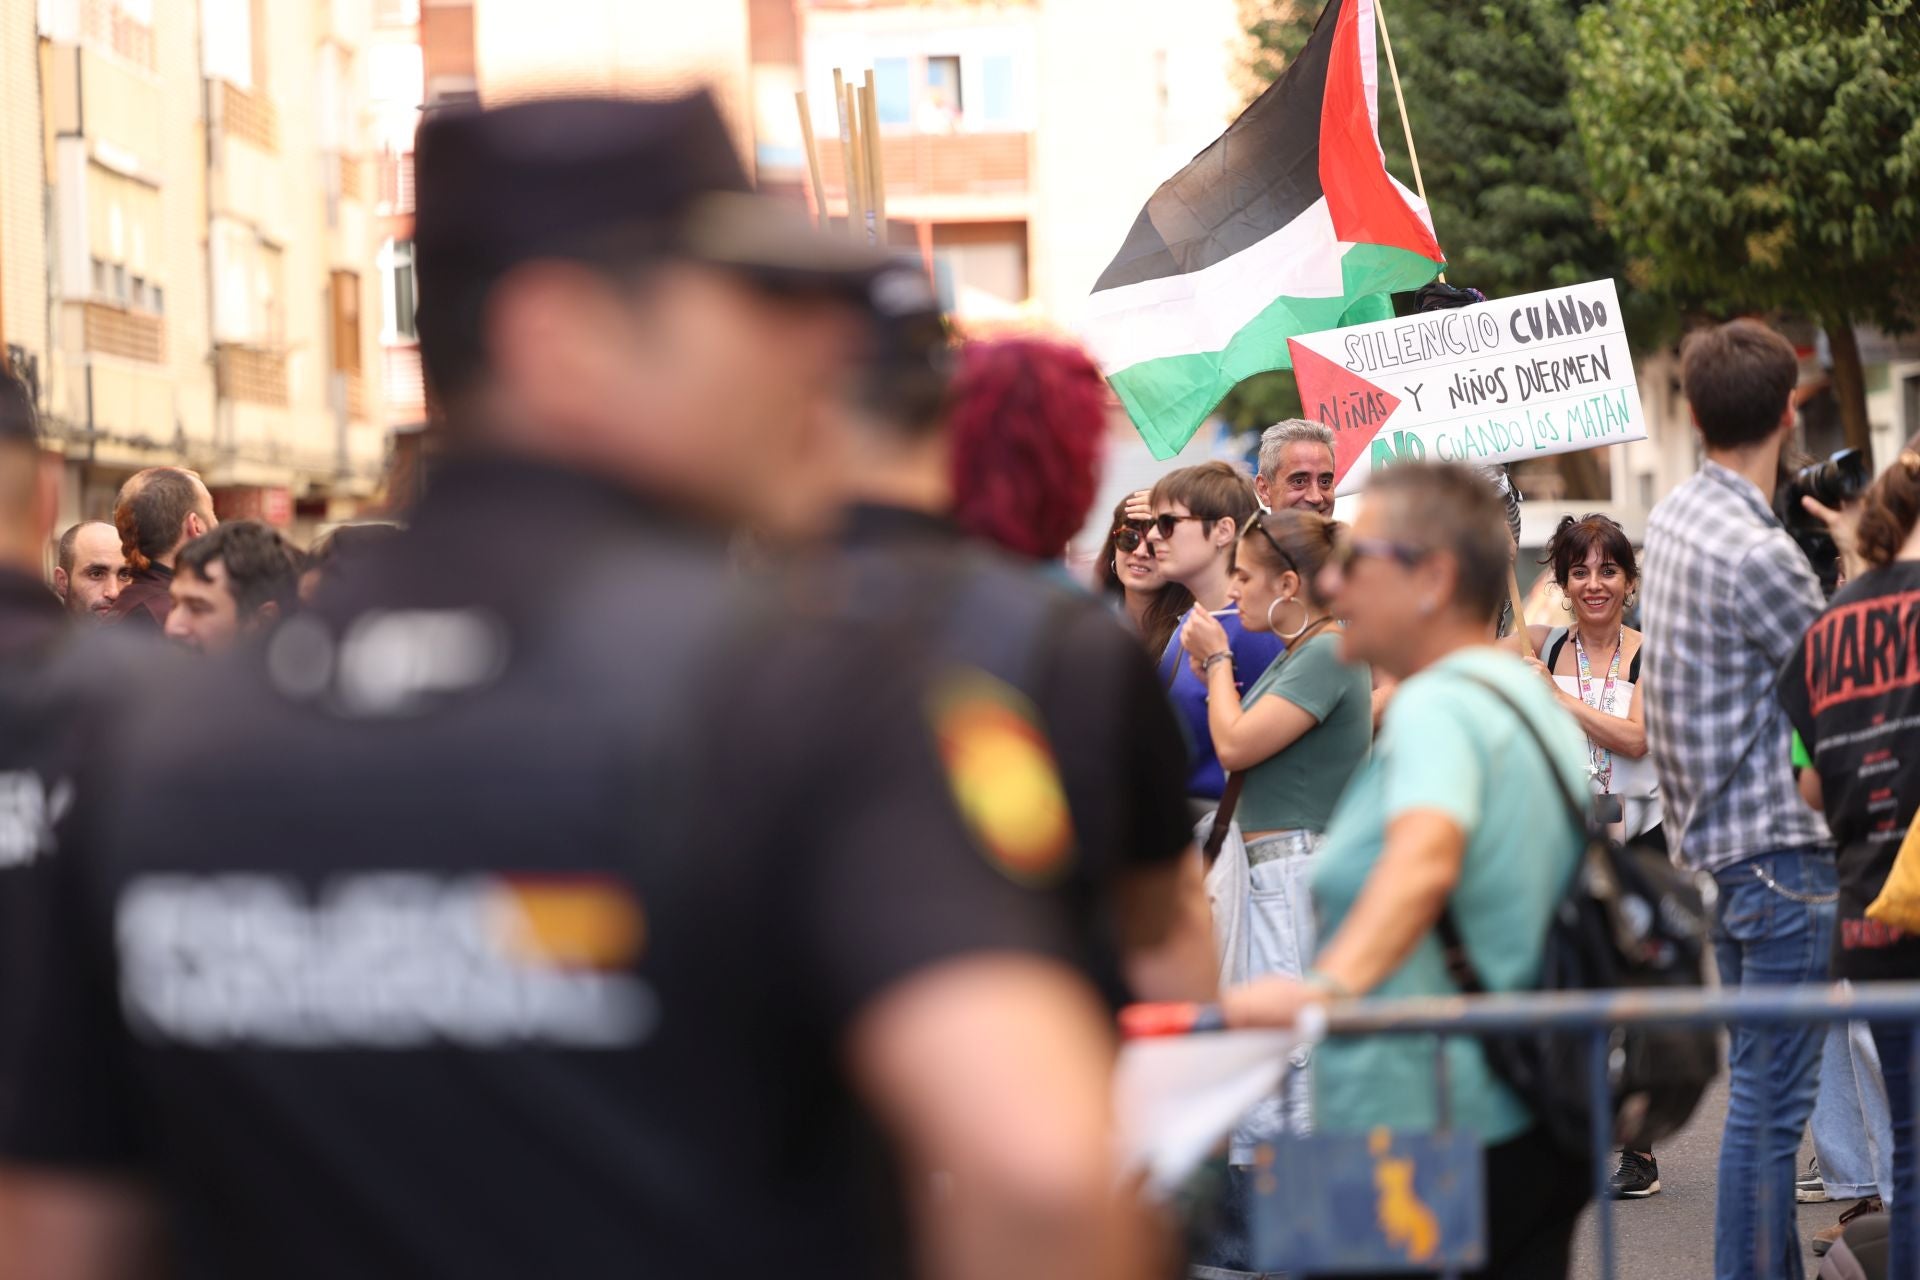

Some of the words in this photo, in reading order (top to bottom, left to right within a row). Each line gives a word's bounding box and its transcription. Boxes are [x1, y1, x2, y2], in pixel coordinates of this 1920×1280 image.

[1344, 312, 1500, 373] SILENCIO
[1509, 294, 1608, 344] CUANDO
[1404, 382, 1424, 412] Y
[1514, 344, 1612, 402] DUERMEN
[1370, 430, 1427, 472] NO
[1566, 388, 1631, 443] MATAN
[1810, 600, 1920, 699] MARV
